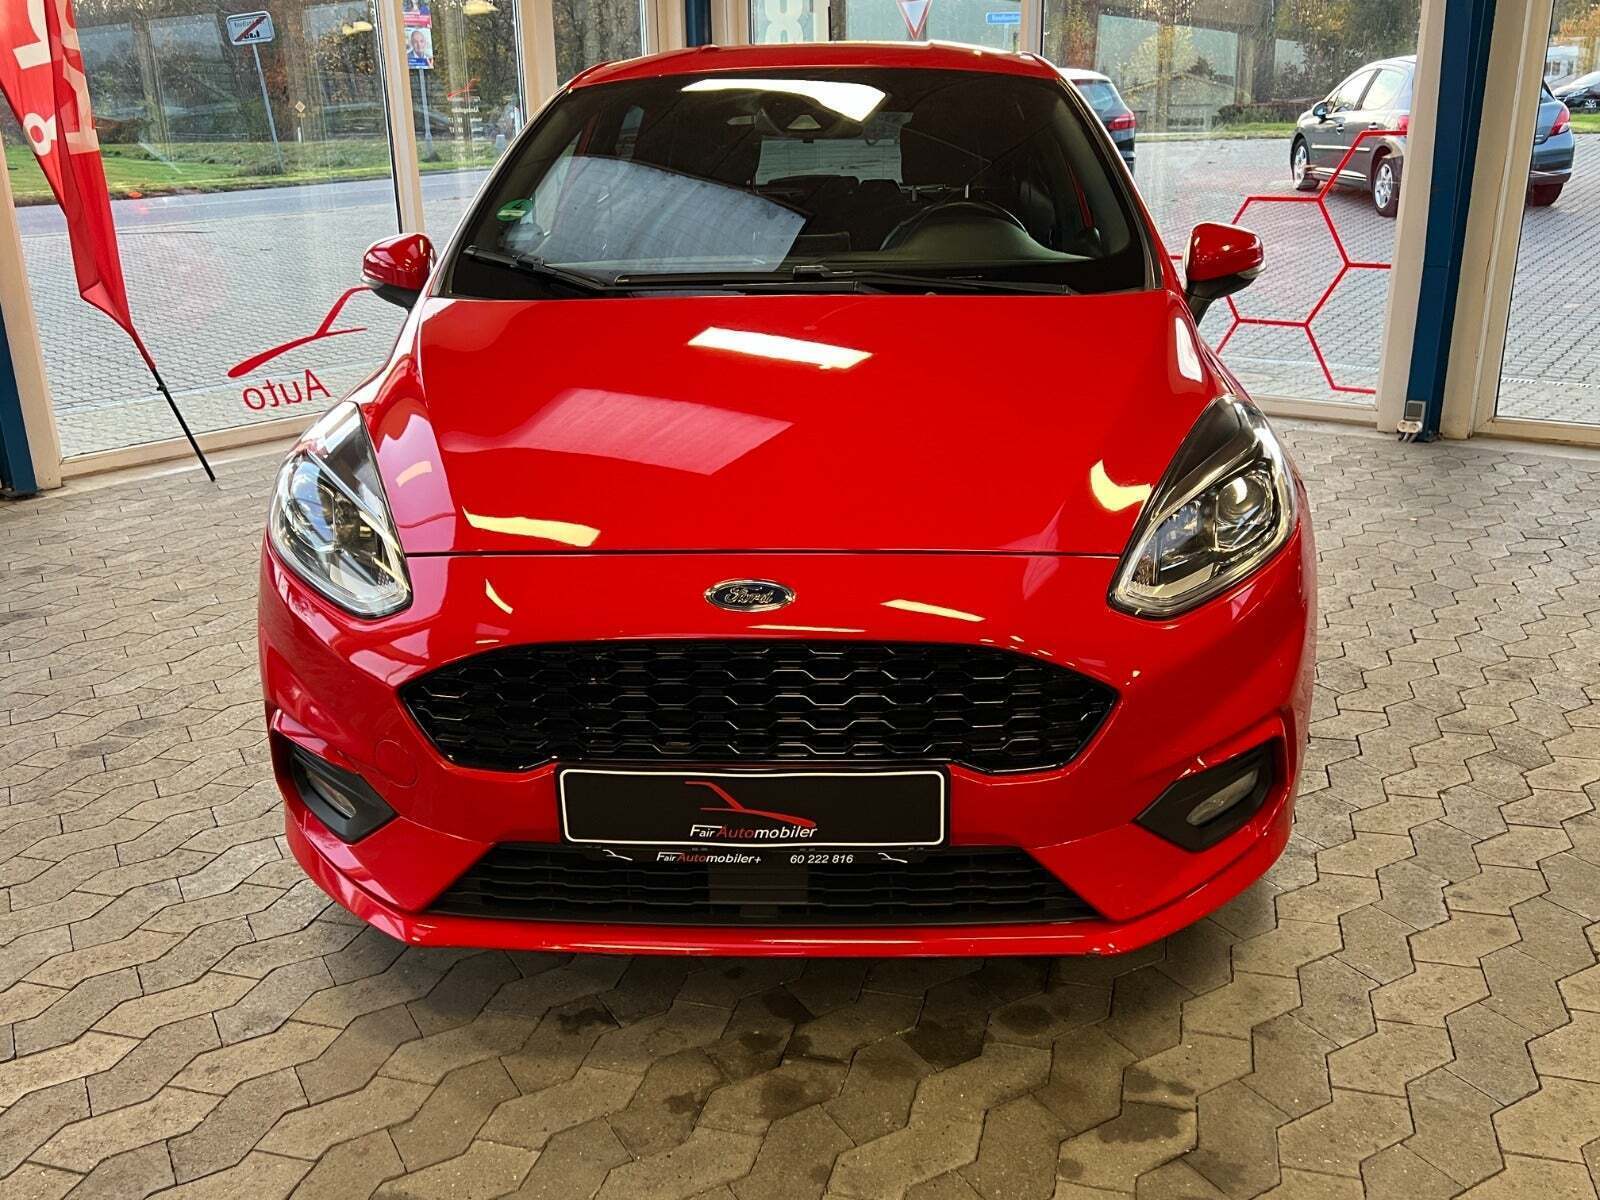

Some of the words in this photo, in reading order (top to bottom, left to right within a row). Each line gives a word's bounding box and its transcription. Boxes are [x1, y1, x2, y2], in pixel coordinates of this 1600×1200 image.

[724, 585, 774, 604] Ford
[790, 855, 804, 864] 60
[807, 855, 829, 864] 222
[832, 854, 854, 864] 816
